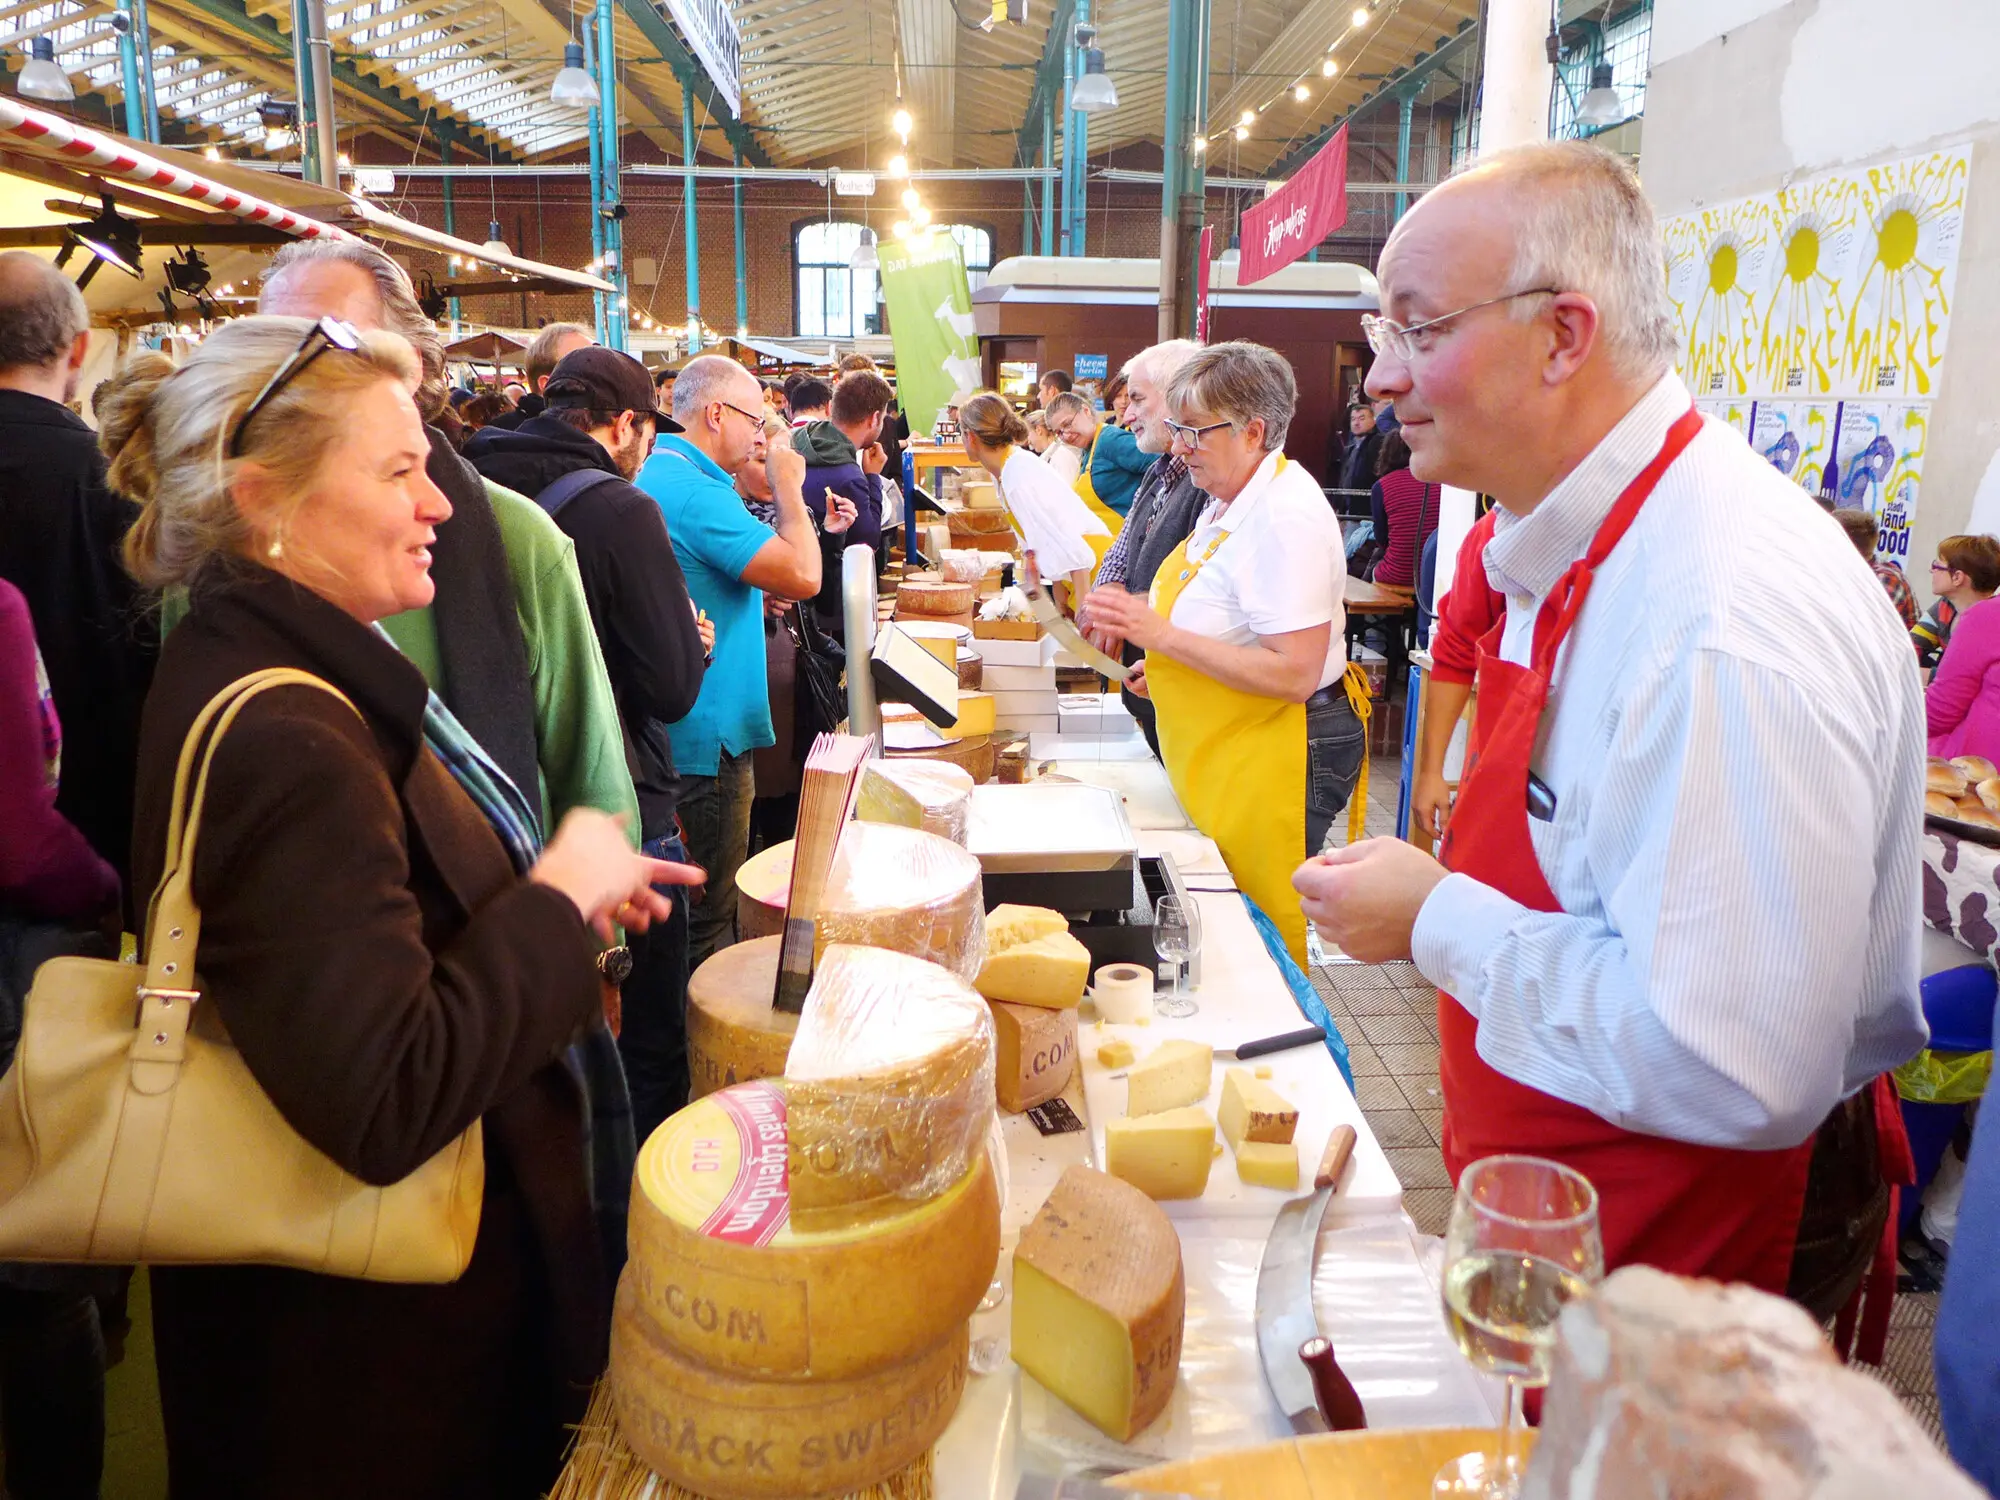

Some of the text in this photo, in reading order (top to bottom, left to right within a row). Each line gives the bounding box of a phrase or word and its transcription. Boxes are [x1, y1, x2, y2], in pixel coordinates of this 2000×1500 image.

[1075, 356, 1108, 368] cheese
[1079, 366, 1103, 375] berlin
[1880, 508, 1907, 530] land
[1877, 527, 1910, 556] ood
[719, 1089, 790, 1234] Almnäs Egendom
